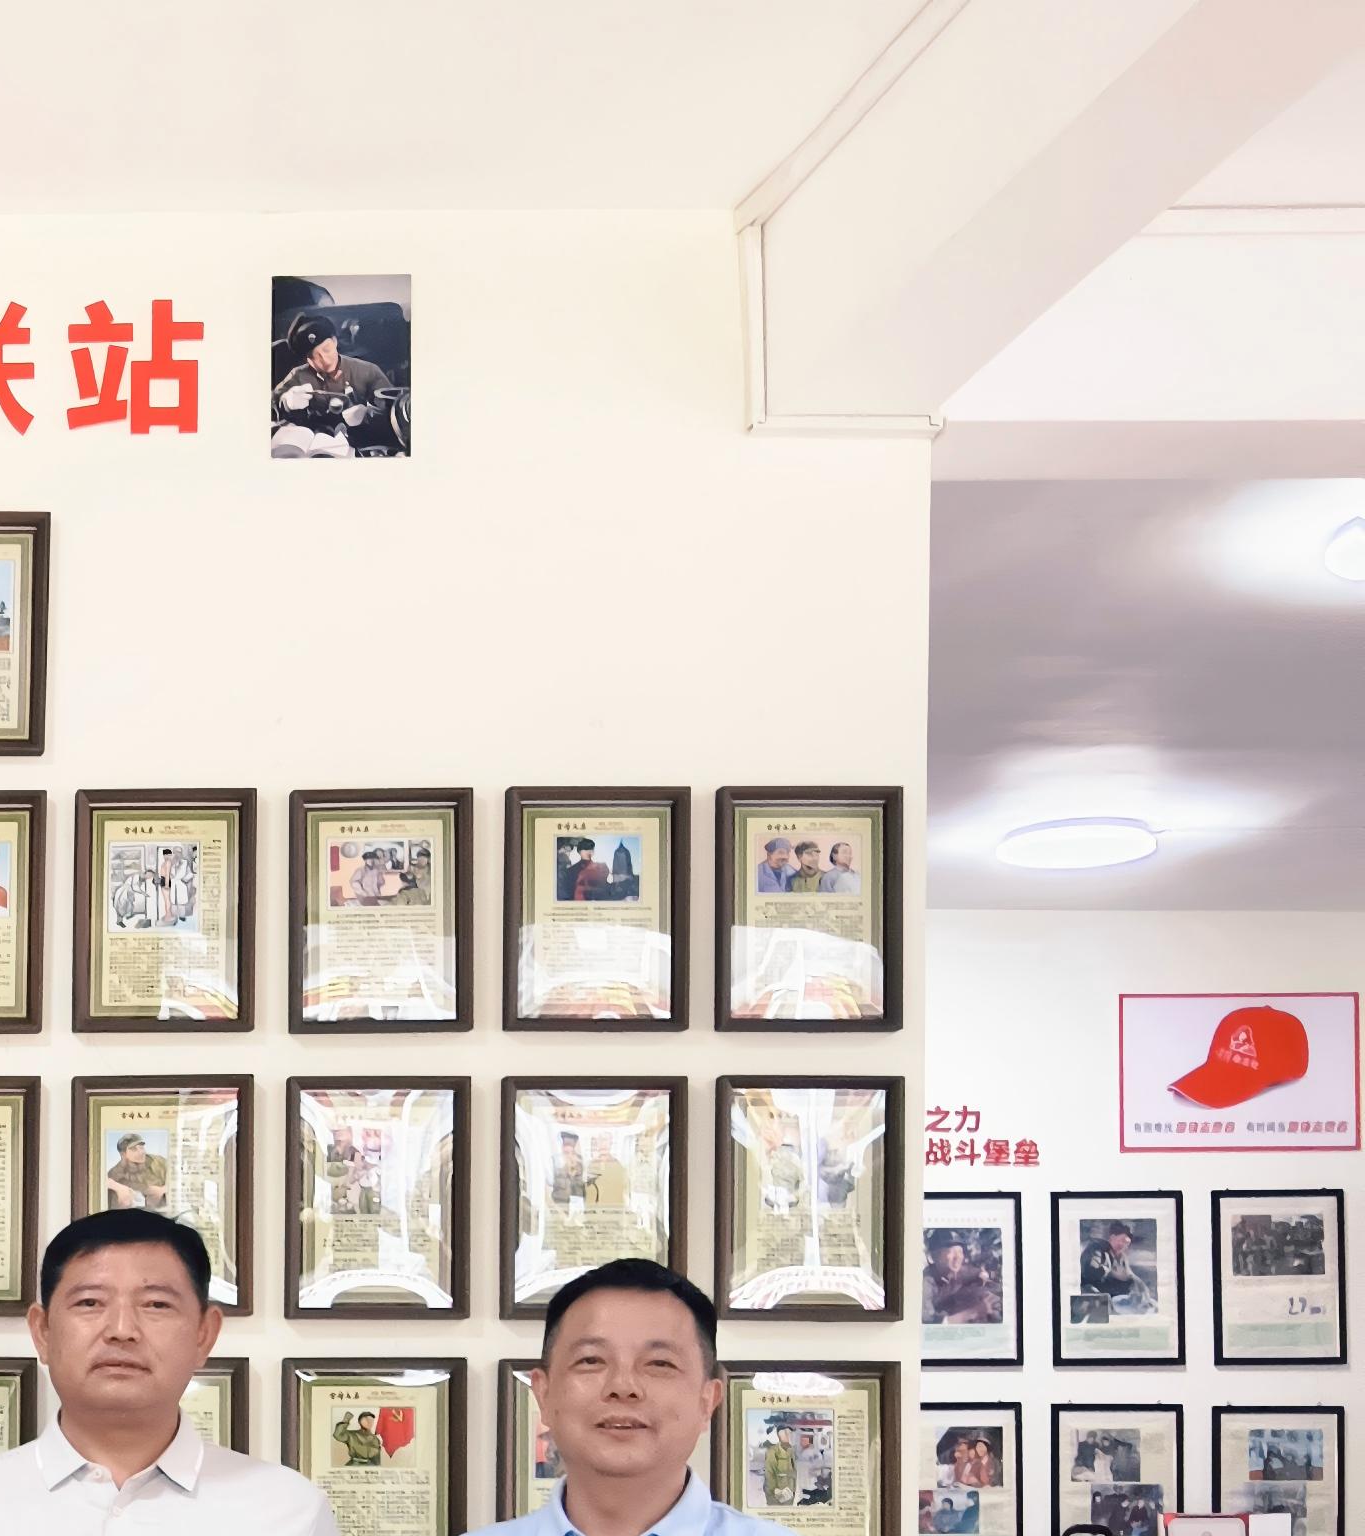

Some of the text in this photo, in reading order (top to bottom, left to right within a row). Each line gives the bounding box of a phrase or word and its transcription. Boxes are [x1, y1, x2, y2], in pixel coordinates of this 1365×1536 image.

[925, 1106, 981, 1133] 之力
[925, 1139, 1040, 1167] 战斗堡垒
